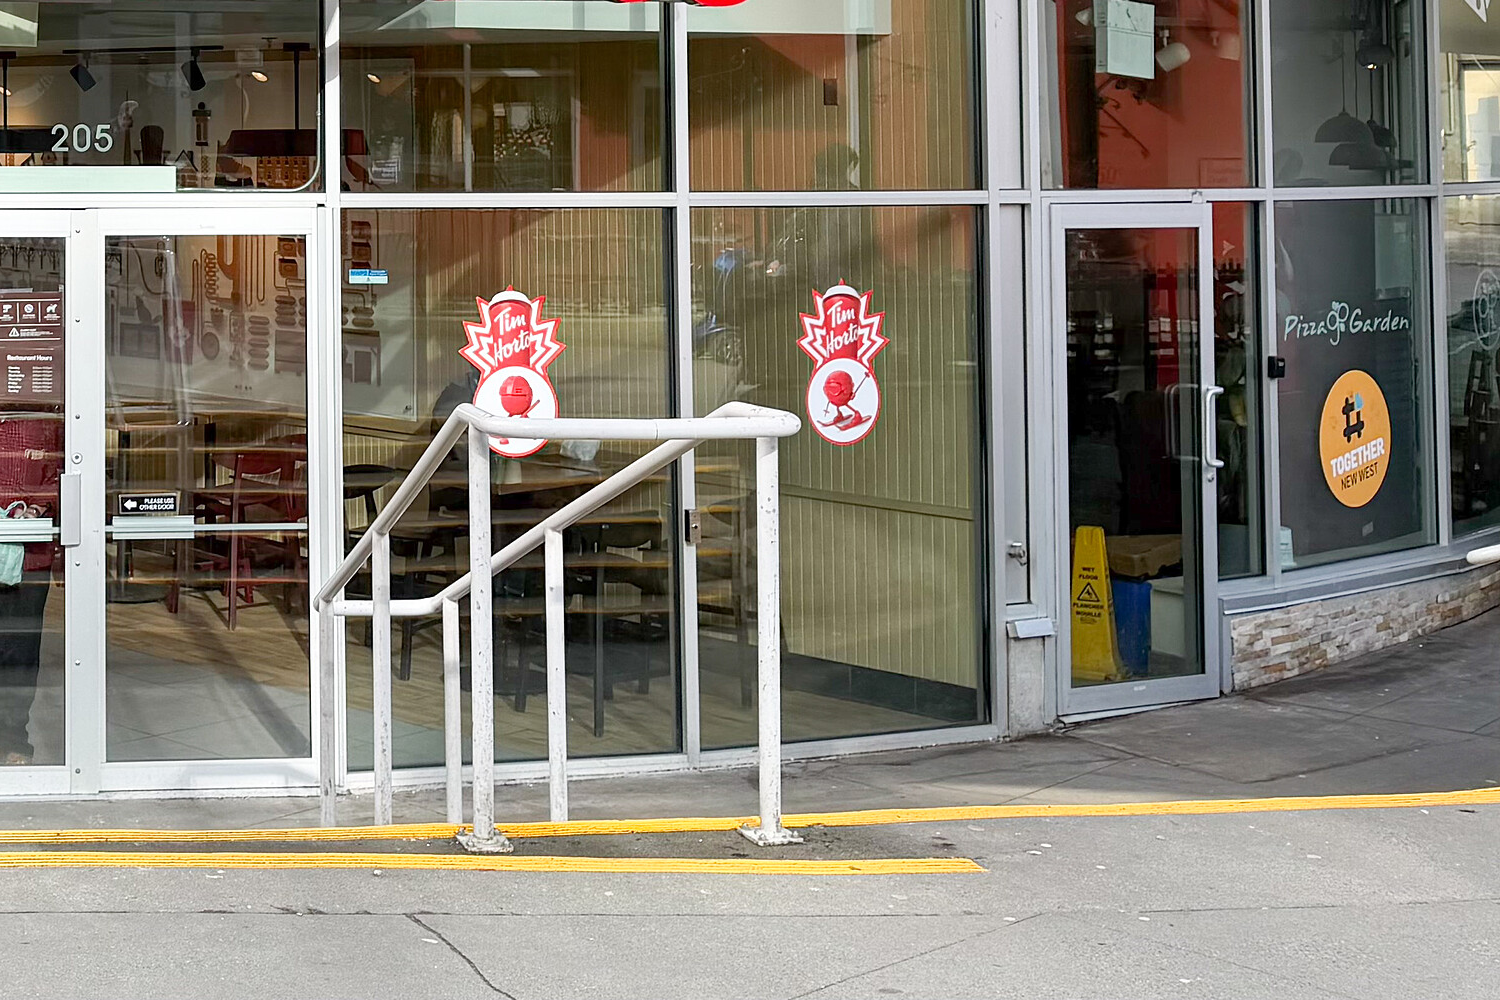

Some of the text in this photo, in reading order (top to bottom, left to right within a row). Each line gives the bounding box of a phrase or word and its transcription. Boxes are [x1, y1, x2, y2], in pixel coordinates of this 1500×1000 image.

[51, 123, 113, 153] 205
[494, 306, 527, 336] Tim
[826, 300, 856, 329] Tim
[1284, 308, 1409, 341] Pizza Garden
[1330, 437, 1385, 478] TOGETHER
[1341, 462, 1379, 490] NEW WEST
